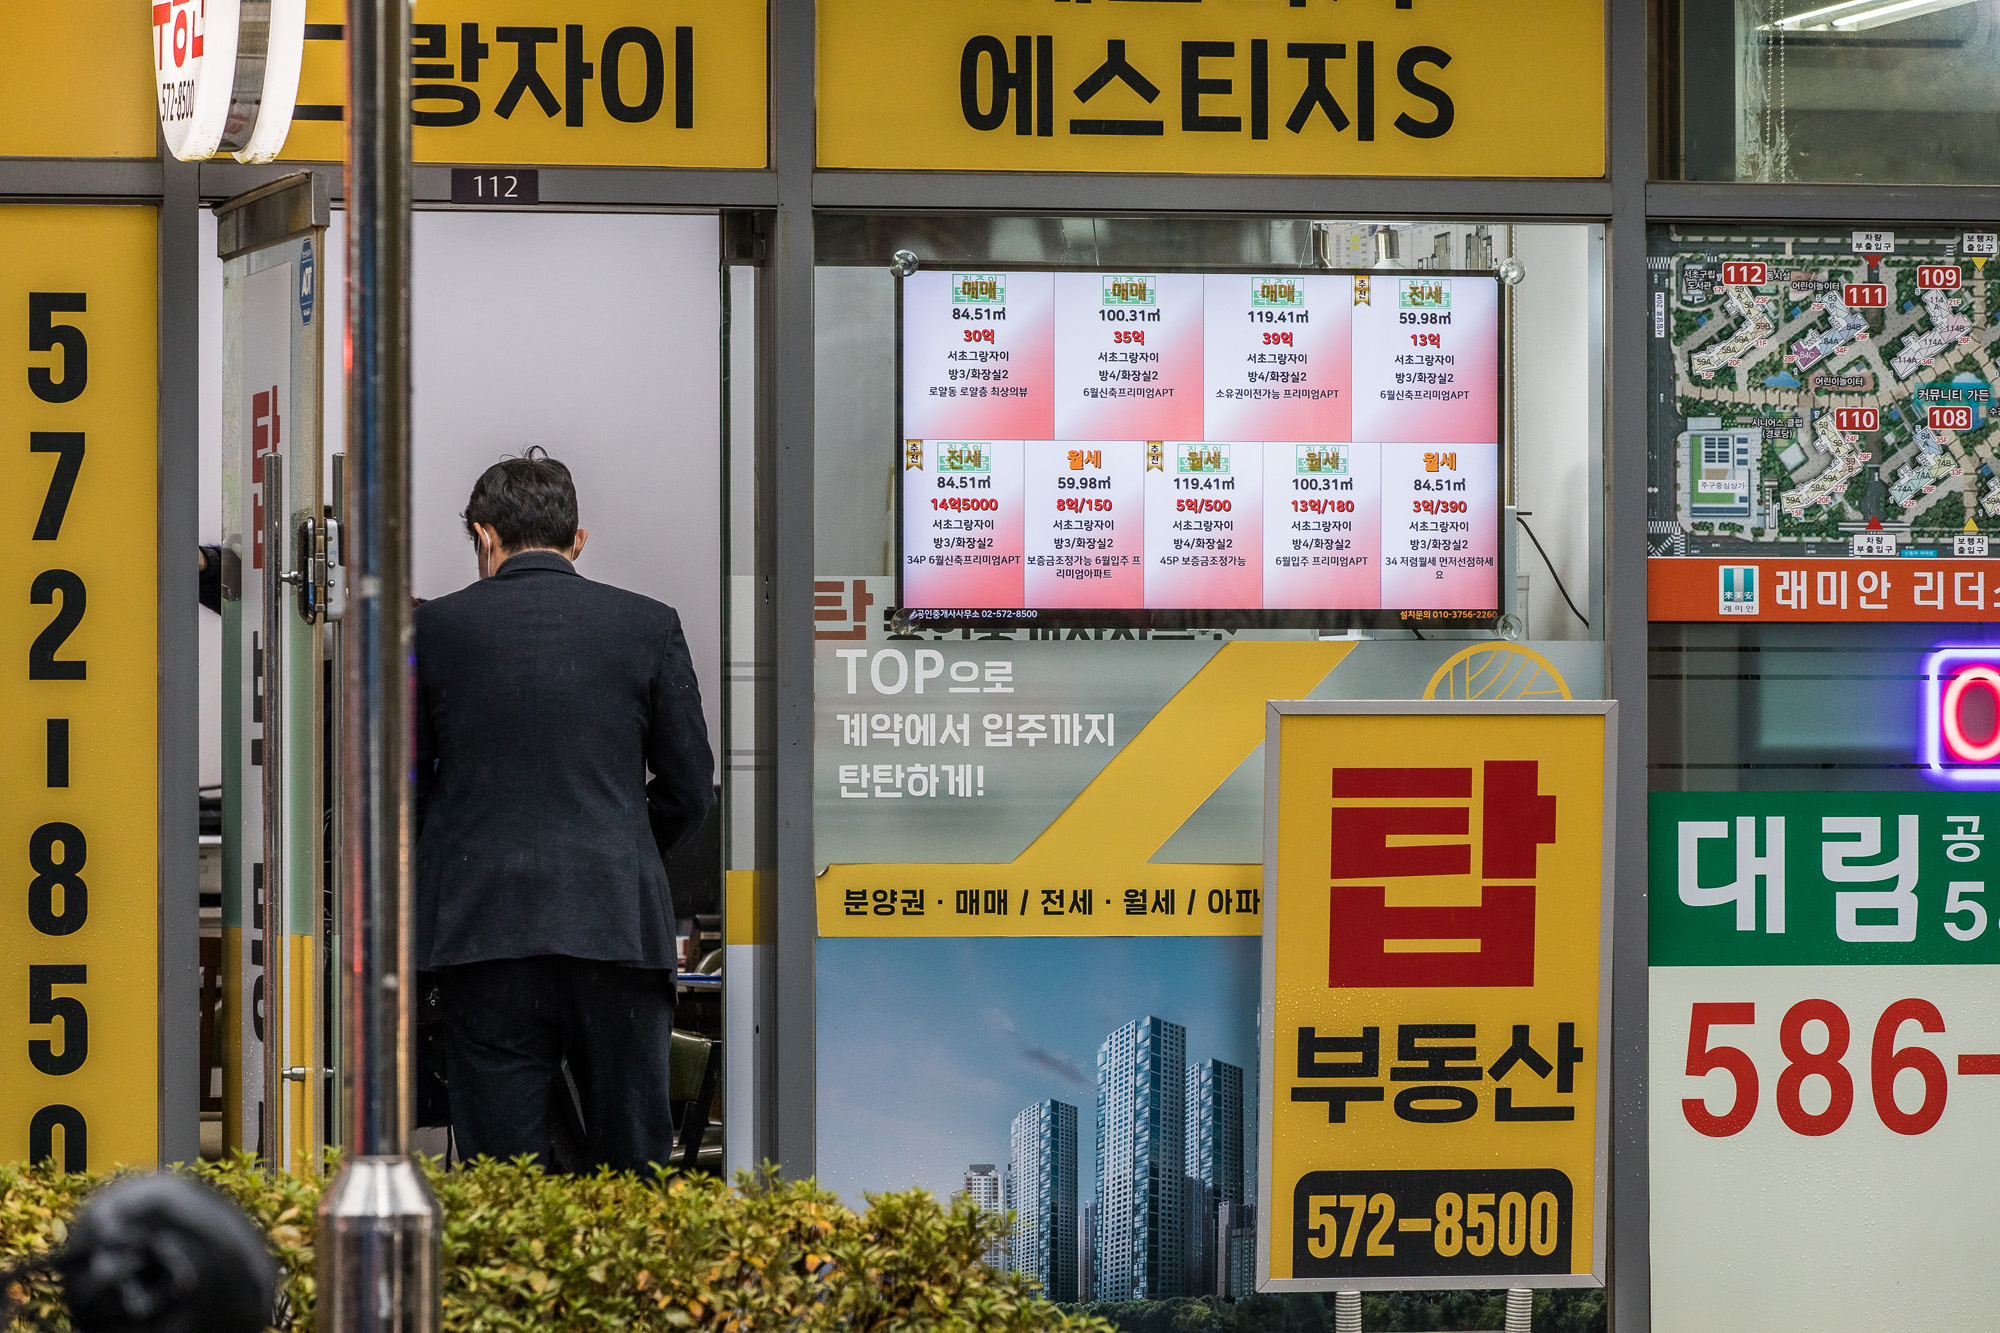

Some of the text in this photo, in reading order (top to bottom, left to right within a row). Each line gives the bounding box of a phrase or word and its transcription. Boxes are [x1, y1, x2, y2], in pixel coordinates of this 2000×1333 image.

[960, 35, 1455, 141] 에스티지S
[162, 79, 195, 123] 572-8500
[474, 175, 518, 198] 112
[1683, 269, 1716, 279] 서초구립
[1727, 265, 1763, 283] 112
[1921, 269, 1957, 286] 109
[962, 280, 996, 300] 매매
[1112, 282, 1146, 301] 매매
[1687, 281, 1711, 290] 도서관
[1792, 282, 1840, 290] 어린이놀이터
[1261, 284, 1294, 303] 매매
[1408, 285, 1442, 305] 전세
[1850, 288, 1883, 304] 111
[952, 307, 1007, 321] 84.51㎡
[1099, 308, 1161, 323] 100.31㎡
[1247, 310, 1309, 324] 119.41㎡
[1399, 311, 1451, 325] 59.98㎡
[963, 329, 995, 344] 30억
[1113, 330, 1145, 345] 35억
[1262, 332, 1294, 347] 39억
[1410, 333, 1441, 348] 13억
[948, 350, 1009, 363] 서초그랑자이
[1098, 351, 1159, 364] 서초그랑자이
[1247, 353, 1307, 365] 서초그랑자이
[1395, 354, 1454, 366] 서초그랑자이
[948, 369, 1009, 381] 방3/화장실2
[1098, 370, 1159, 382] 방4/화장실2
[1247, 371, 1307, 383] 방4/화장실2
[1395, 372, 1454, 384] 방3/화장실2
[1816, 377, 1863, 386] 어린이놀이터
[990, 386, 1028, 397] 최상의뷰
[1083, 387, 1175, 398] 6월신축프리미엄APT
[1216, 388, 1340, 400] 소유권이전가능 프리미엄APT
[1380, 390, 1470, 401] 6월신축프리미엄APT
[1918, 389, 1990, 401] 커뮤니티 가든
[1752, 418, 1803, 427] 시니어스 클럽
[1840, 411, 1874, 428] 110
[1932, 410, 1967, 426] 108
[1762, 429, 1793, 439] (경로당)
[946, 449, 982, 470] 전세
[1066, 449, 1102, 470] 월세
[1187, 451, 1221, 471] 월세
[1305, 451, 1339, 472] 월세
[1423, 452, 1457, 472] 월세
[937, 475, 991, 489] 84.51㎡
[1057, 476, 1111, 490] 59.98㎡
[1173, 477, 1235, 491] 119.41㎡
[1292, 477, 1353, 491] 100.31㎡
[1413, 478, 1466, 491] 84.51㎡
[930, 497, 998, 513] 14억5000
[1056, 498, 1112, 513] 8억/150
[1176, 499, 1232, 514] 5억/500
[1291, 499, 1354, 514] 13억/180
[1412, 500, 1467, 514] 3억/390
[932, 520, 994, 531] 서초그랑자이
[1053, 520, 1114, 531] 서초그랑자이
[1172, 521, 1234, 532] 서초그랑자이
[1291, 521, 1352, 532] 서초그랑자이
[1409, 521, 1469, 532] 서초그랑자이
[933, 537, 994, 549] 방3/화장실2
[1053, 538, 1114, 550] 방3/화장실2
[1173, 538, 1233, 550] 방4/화장실2
[1292, 539, 1351, 550] 방4/화장실2
[1410, 539, 1469, 551] 방3/화장실2
[907, 555, 1021, 566] 34P 6월신축프리미엄APT
[1027, 555, 1141, 566] 보증금조정가능 6월입주 프
[1160, 556, 1246, 567] 45P 보증금조정가능
[1275, 556, 1368, 567] 6월입주 프리미엄APT
[1385, 556, 1494, 567] 34 저렴월세 먼저선점하세
[1056, 568, 1112, 580] 리미엄아파트
[1435, 570, 1444, 580] 요
[1776, 570, 2000, 610] 래미안 리더
[982, 610, 1037, 618] 02-572-8500
[1400, 610, 1498, 620] 설치문의 010-3756-2260
[1723, 605, 1754, 613] 래미안
[836, 648, 1014, 695] TOP으로
[836, 713, 1115, 747] 계약에서 입주까지
[838, 763, 985, 798] 탄탄하게!
[1329, 760, 1557, 988] 탑
[1678, 815, 1919, 943] 대림
[844, 888, 925, 916] 분양권
[955, 888, 1008, 916] 매매
[1040, 888, 1093, 916] 전세
[1123, 888, 1176, 916] 월세
[1943, 881, 2000, 942] 5
[1290, 1022, 1584, 1124] 부동산
[1307, 1190, 1559, 1259] 572-8500
